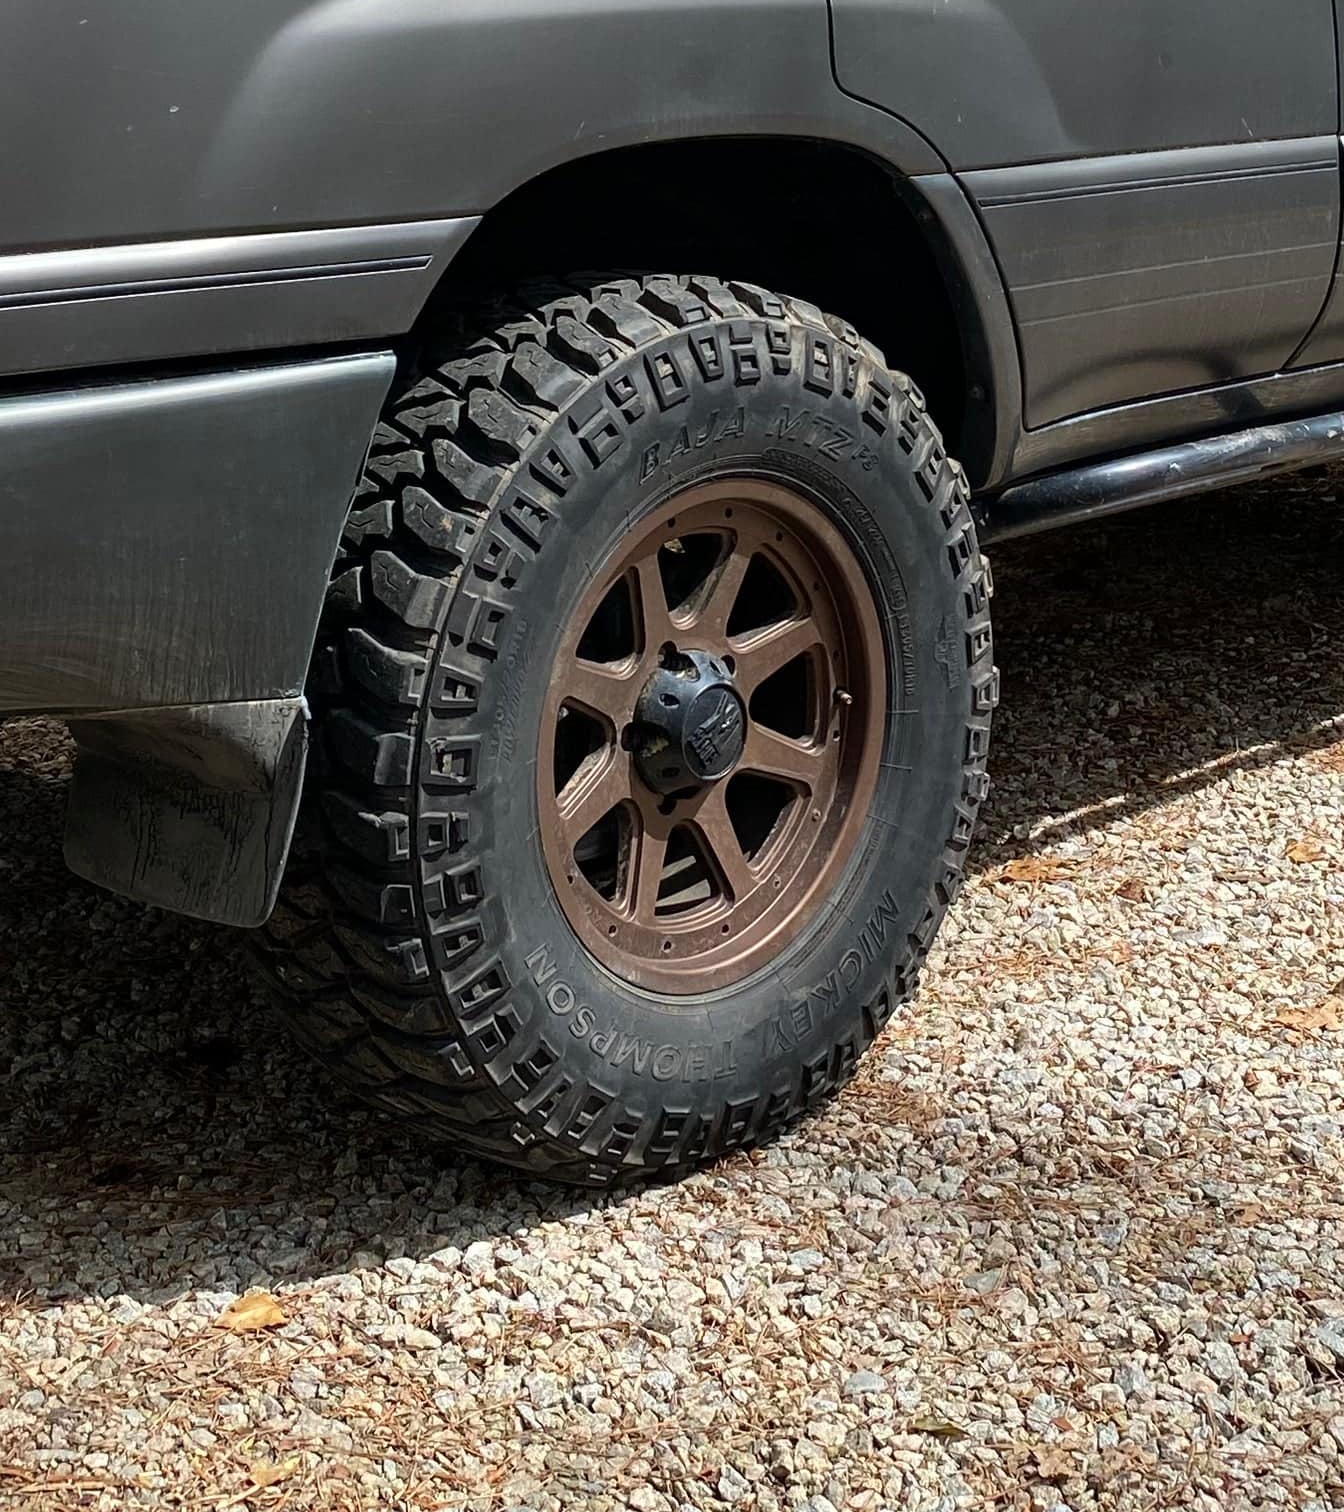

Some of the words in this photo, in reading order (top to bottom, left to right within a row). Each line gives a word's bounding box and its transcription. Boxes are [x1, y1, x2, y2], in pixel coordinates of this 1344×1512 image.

[639, 404, 746, 486] BAJA
[523, 943, 738, 1083] THOMPSON
[768, 888, 902, 1054] MICKEY
